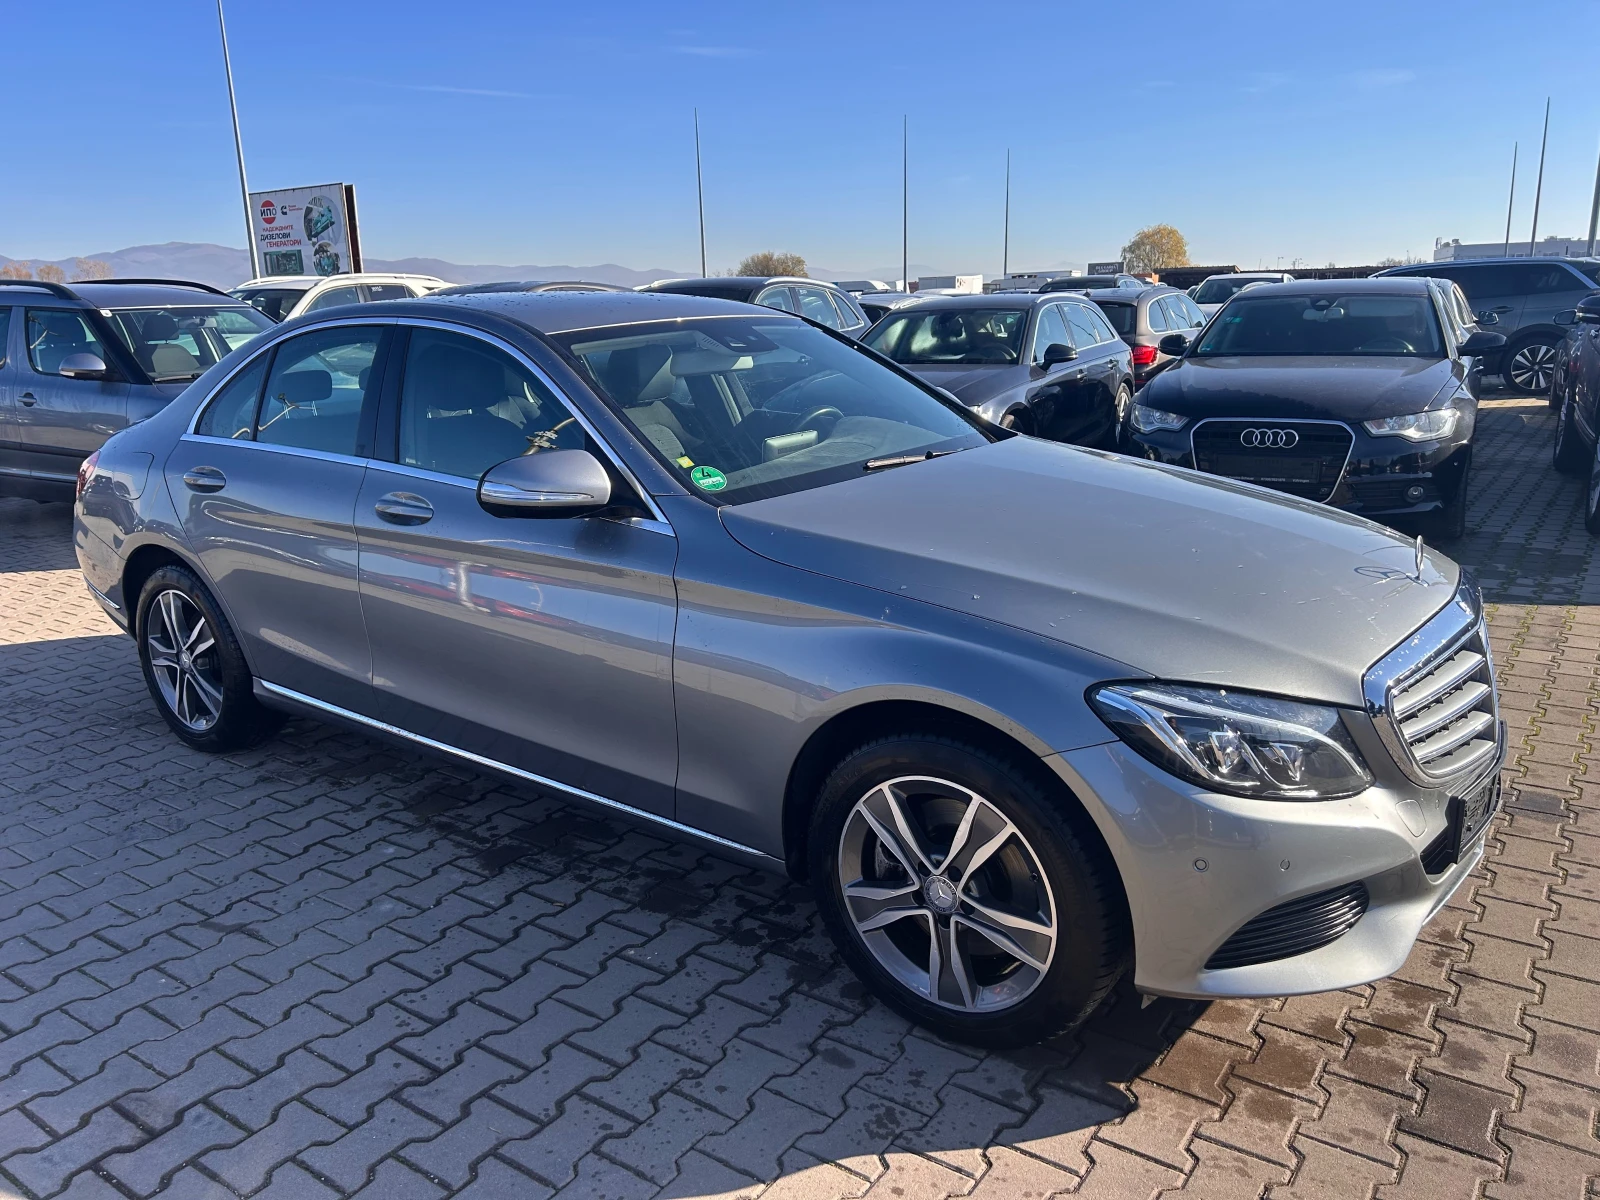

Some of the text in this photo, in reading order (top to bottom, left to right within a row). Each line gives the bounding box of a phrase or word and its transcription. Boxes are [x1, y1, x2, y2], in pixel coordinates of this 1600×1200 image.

[260, 208, 277, 217] ИПО
[260, 232, 291, 242] ДИЗЕЛОВИ
[266, 239, 302, 248] ГЕНЕРАТОРИ
[701, 468, 712, 478] 4
